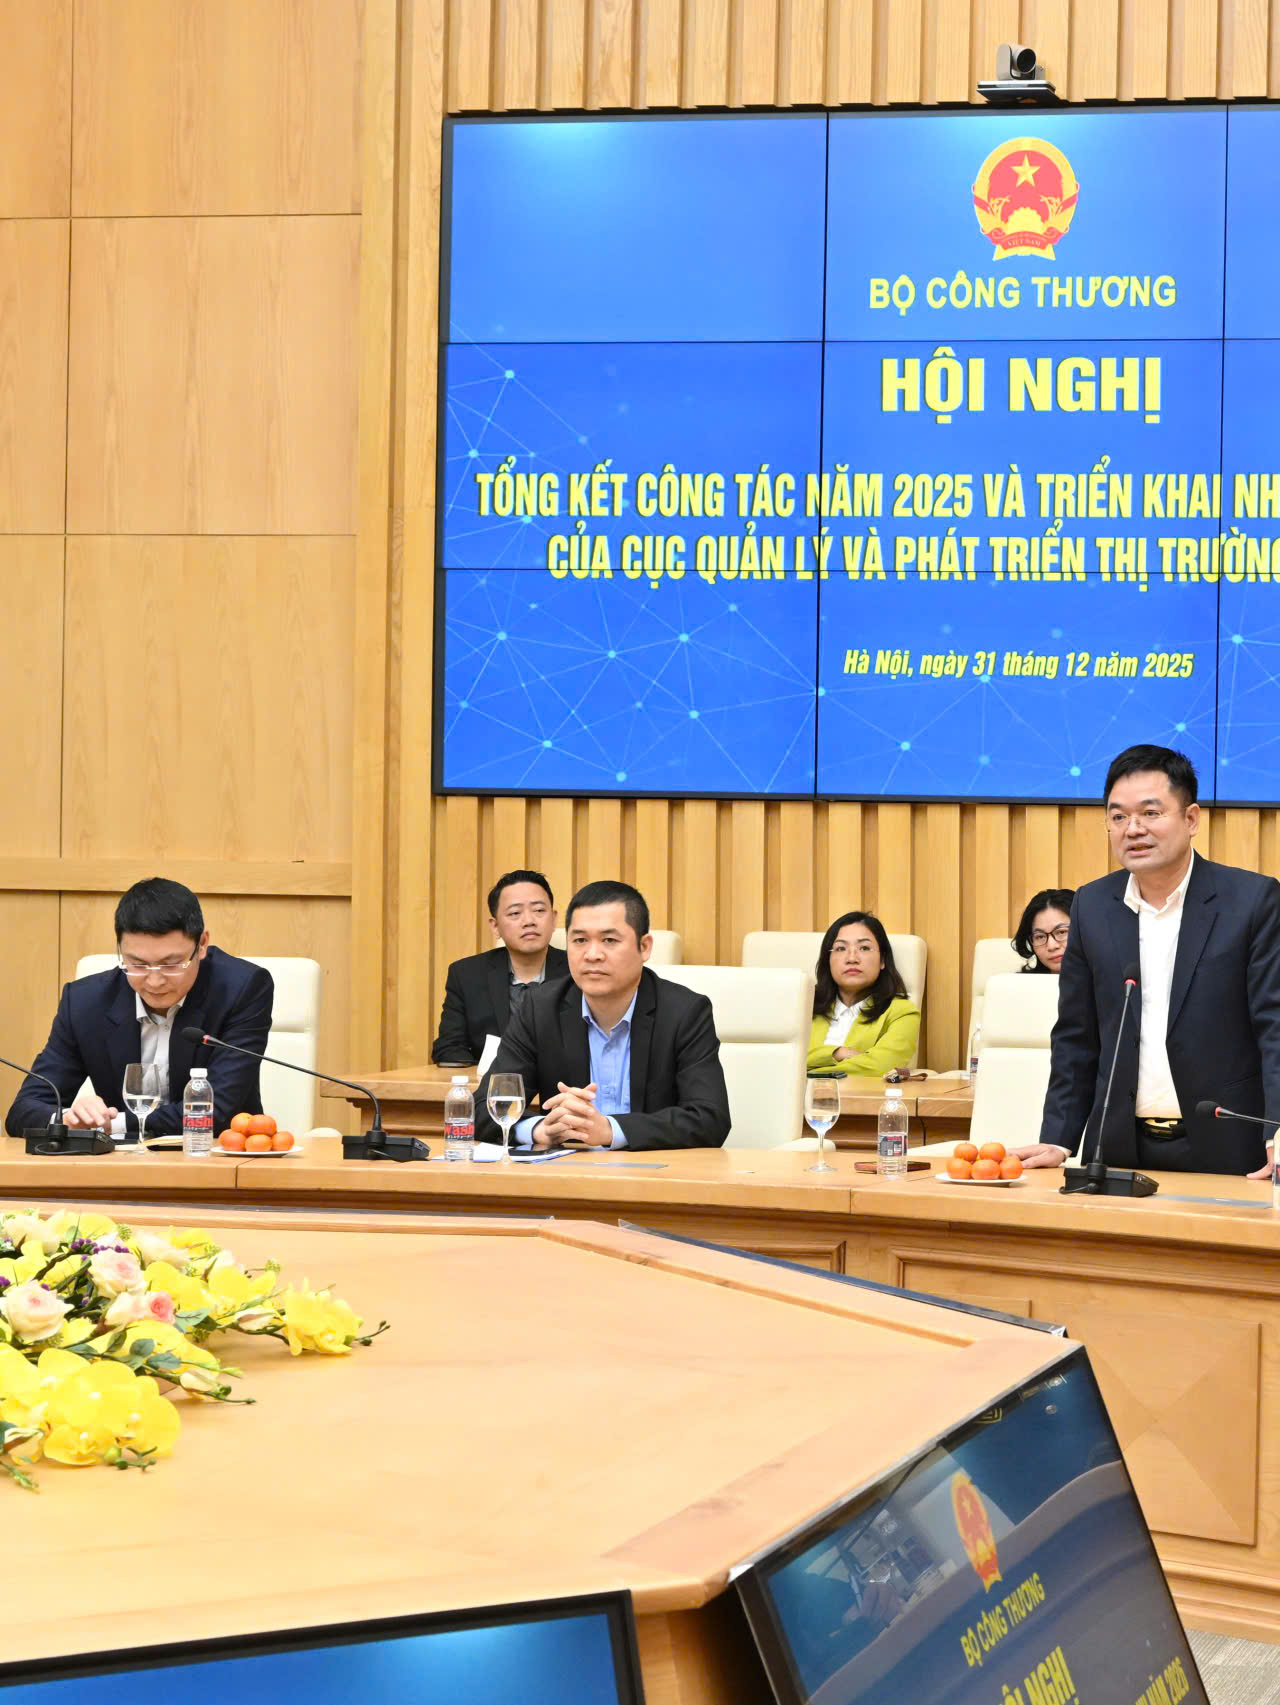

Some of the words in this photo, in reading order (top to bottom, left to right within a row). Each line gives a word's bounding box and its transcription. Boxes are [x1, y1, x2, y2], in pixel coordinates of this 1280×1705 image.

[870, 274, 916, 316] BỘ
[927, 270, 1021, 309] CÔNG
[1031, 275, 1176, 308] THƯƠNG
[882, 346, 984, 425] HỘI
[1009, 356, 1161, 424] NGHỊ
[476, 455, 558, 517] TỔNG
[569, 459, 626, 517] KẾT
[637, 463, 723, 517] CÔNG
[734, 463, 794, 518] TÁC
[806, 464, 882, 517] NĂM
[893, 473, 972, 518] 2025
[983, 463, 1025, 518] VÀ
[1036, 455, 1131, 521] TRIỂN
[1143, 473, 1221, 518] KHAI
[548, 520, 613, 579] CỦA
[622, 535, 686, 589] CỤC
[696, 521, 785, 585] QUẢN
[795, 526, 833, 580] LÝ
[842, 526, 887, 580] VÀ
[895, 527, 979, 581] PHÁT
[989, 515, 1086, 582] TRIỂN
[1095, 537, 1148, 593] THỊ
[843, 649, 870, 674] Hà
[874, 649, 913, 679] Nội,
[919, 650, 969, 678] ngày
[973, 651, 996, 676] 31
[1002, 651, 1059, 679] tháng
[1066, 652, 1090, 677] 12
[1094, 652, 1139, 677] năm
[1143, 652, 1194, 678] 2025
[960, 1627, 983, 1668] BỘ
[976, 1605, 1009, 1652] CÔNG
[1002, 1572, 1046, 1627] THƯƠNG
